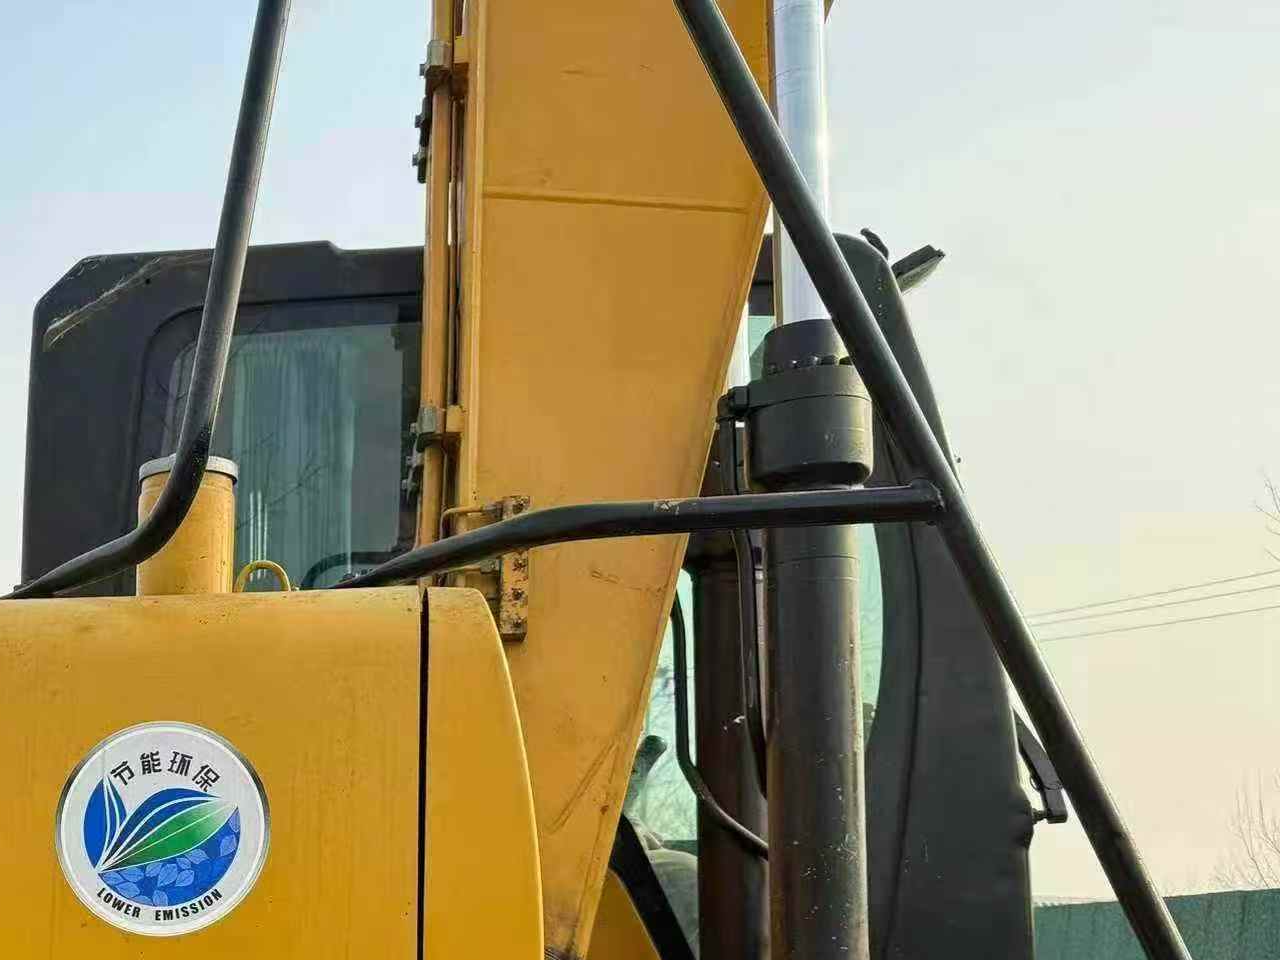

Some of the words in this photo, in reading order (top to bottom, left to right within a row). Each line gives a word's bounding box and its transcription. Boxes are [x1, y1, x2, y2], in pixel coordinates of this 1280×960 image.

[110, 751, 220, 792] 节能环保
[96, 887, 141, 919] LOWER
[155, 889, 223, 921] EMISSION
